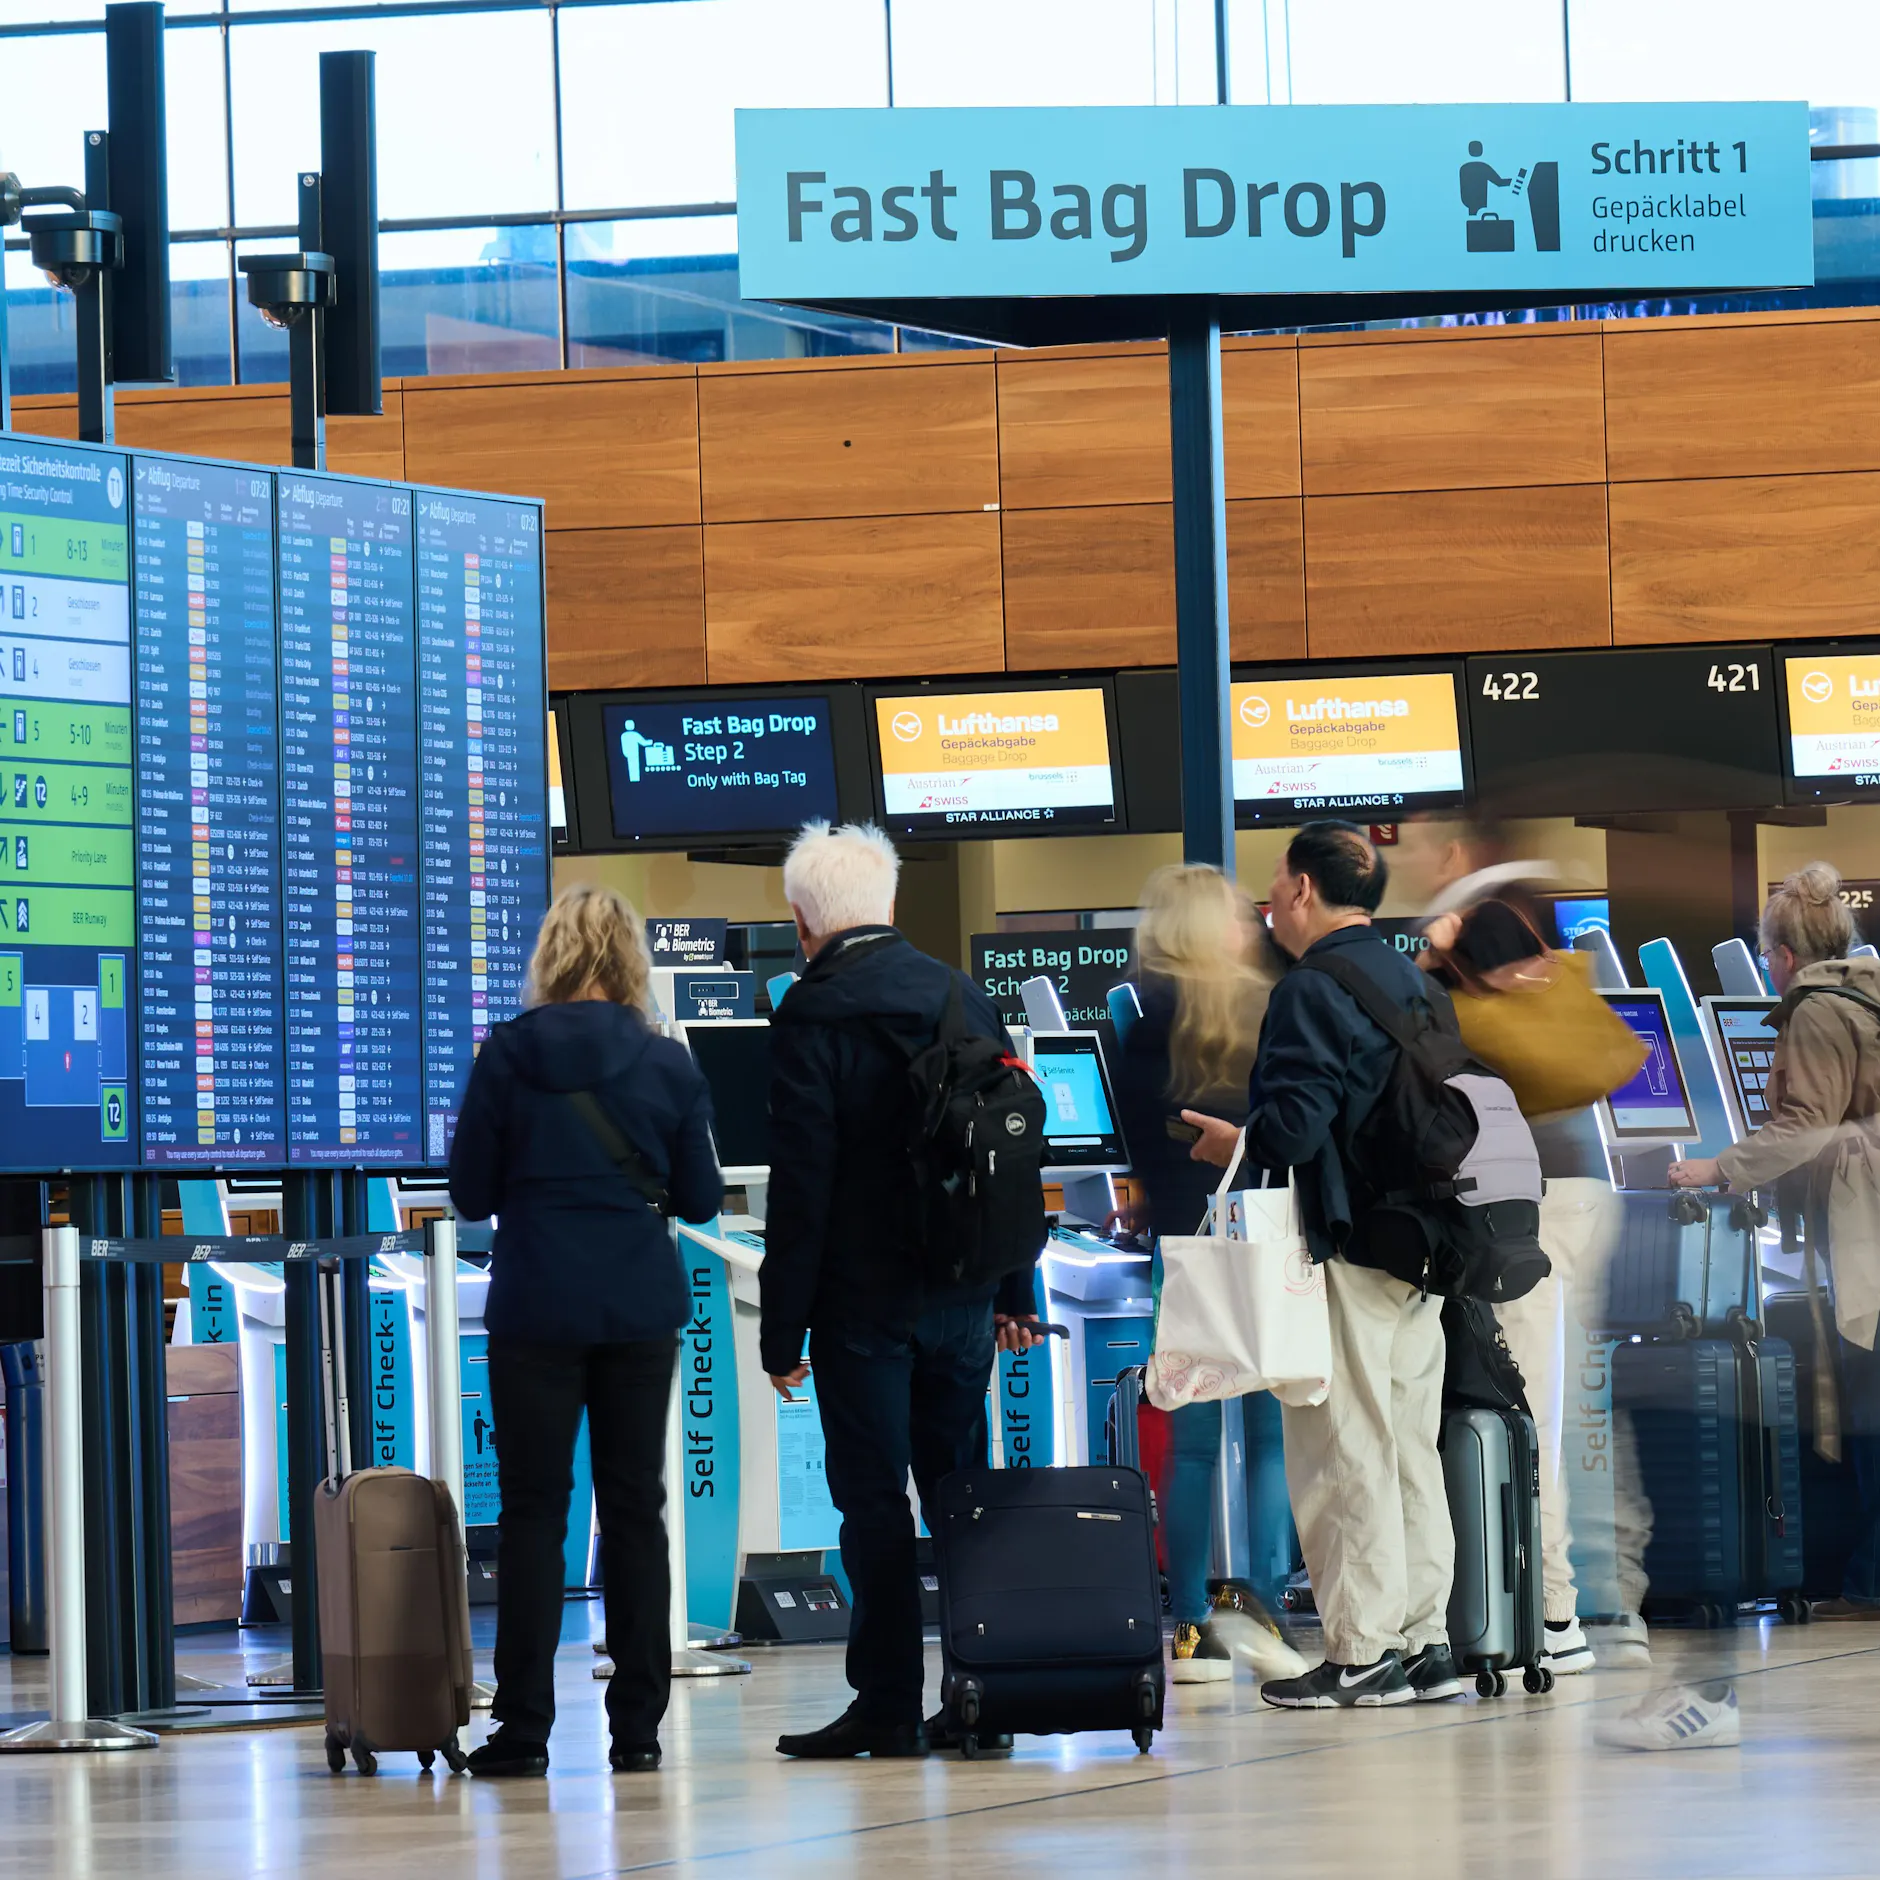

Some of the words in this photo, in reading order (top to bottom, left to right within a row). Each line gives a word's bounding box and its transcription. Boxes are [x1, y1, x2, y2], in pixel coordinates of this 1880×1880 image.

[1591, 139, 1722, 176] Schritt
[1730, 140, 1749, 174] 1
[785, 168, 959, 243] Fast
[988, 168, 1150, 263] Bag
[1183, 166, 1387, 258] Drop
[1591, 192, 1747, 227] Gepäcklabel
[1592, 227, 1696, 253] drucken
[22, 456, 101, 482] Sicherheitskontrolle
[148, 467, 171, 491] Abflug
[250, 480, 269, 498] 07:21
[7, 482, 23, 499] Time
[24, 484, 49, 505] Security
[50, 487, 73, 504] Control
[392, 497, 410, 515] 07:21
[430, 501, 450, 525] Abflug
[521, 514, 538, 532] 07:21
[67, 538, 88, 560] 8-13
[32, 596, 38, 617] 2
[33, 658, 39, 679] 4
[1707, 663, 1760, 692] 421
[1482, 671, 1540, 701] 422
[1286, 697, 1410, 721] Lufthansa
[34, 720, 40, 742] 5
[70, 723, 91, 745] 5-10
[682, 716, 722, 736] Fast
[727, 715, 765, 738] Bag
[769, 714, 816, 735] Drop
[937, 711, 1059, 736] Lufthansa
[1289, 721, 1385, 736] Gepäckabgabe
[684, 742, 728, 764] Step
[732, 741, 745, 759] 2
[941, 736, 1036, 751] Gepäckabgabe
[1290, 737, 1344, 751] Baggage
[1347, 735, 1377, 749] Drop
[1816, 740, 1866, 751] Austrian
[942, 752, 995, 766] Baggage
[997, 749, 1027, 763] Drop
[1378, 757, 1413, 767] brussels
[1844, 758, 1879, 768] SWISS
[1028, 771, 1063, 781] brussels
[1254, 763, 1304, 775] Austrian
[687, 773, 718, 790] Only
[721, 771, 750, 786] with
[754, 771, 779, 787] Bag
[782, 770, 806, 786] Tag
[907, 777, 956, 790] Austrian
[1282, 782, 1317, 792] SWISS
[71, 785, 88, 806] 4-9
[934, 796, 968, 806] SWISS
[1293, 797, 1325, 809] STAR
[1328, 795, 1389, 808] ALLIANCE
[945, 811, 977, 823] STAR
[980, 809, 1040, 822] ALLIANCE
[72, 850, 92, 866] Priority
[93, 852, 107, 864] Lane
[1839, 890, 1873, 908] 225
[73, 912, 83, 924] BER
[673, 924, 690, 937] BER
[672, 937, 715, 952] Biometrics
[984, 949, 1026, 968] Fast
[1032, 948, 1071, 971] Bag
[1078, 946, 1128, 968] Drop
[1058, 976, 1070, 993] 2
[7, 970, 13, 991] 5
[35, 1004, 40, 1024] 4
[83, 1004, 88, 1025] 2
[109, 973, 114, 993] 1
[708, 999, 718, 1007] BER
[709, 1007, 733, 1016] Biometrics
[108, 1102, 120, 1122] T2
[91, 1239, 108, 1256] BER
[191, 1245, 211, 1260] BER
[287, 1243, 306, 1258] BER
[380, 1235, 396, 1251] BER
[686, 1267, 712, 1419] Check-in
[375, 1420, 395, 1469] elf
[1007, 1410, 1031, 1468] Self
[1579, 1403, 1607, 1472] Self
[688, 1430, 714, 1498] Self
